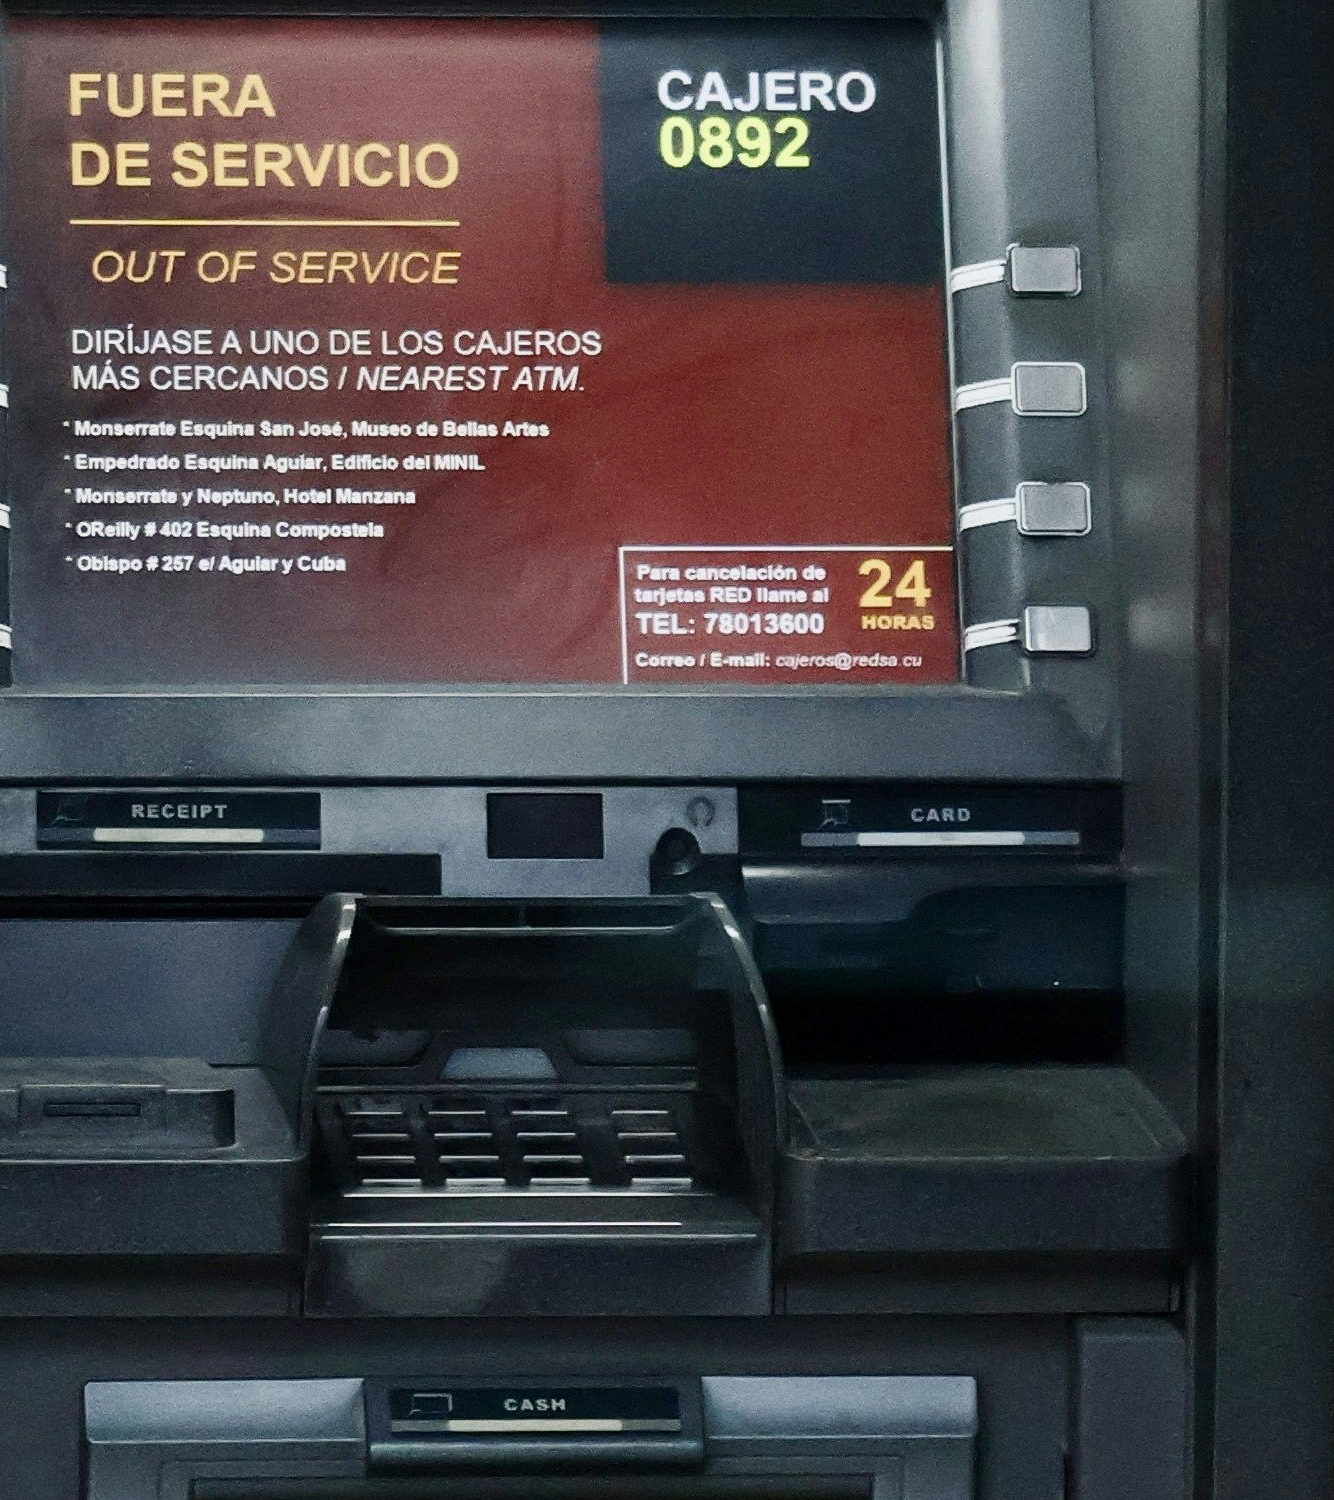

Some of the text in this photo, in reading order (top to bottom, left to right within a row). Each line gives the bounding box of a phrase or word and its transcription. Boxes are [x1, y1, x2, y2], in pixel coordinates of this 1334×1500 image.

[69, 72, 277, 118] FUERA
[657, 69, 876, 113] CAJERO
[659, 115, 810, 168] 0892
[71, 141, 459, 189] DE SERVICIO
[92, 250, 462, 284] OUT OF SERVICE
[71, 323, 602, 356] DIRÍJASE A UNO DE LOS CAJEROS
[72, 358, 140, 390] MÁS
[149, 364, 329, 391] CERCANOS
[356, 365, 509, 391] NEAREST
[511, 365, 585, 392] ATM.
[74, 419, 550, 440] Monserrate Esquina San José, Museo de Bellas Artes
[74, 453, 486, 474] Empedrado Esquina Aguiar, Edificio del MINIL
[74, 487, 416, 507] Monserrate y Neptuno, Hotel Manzana
[143, 521, 157, 537] #
[158, 521, 193, 538] 402
[195, 521, 272, 541] Esquina
[275, 521, 384, 541] Compostela
[77, 555, 143, 575] Obispo
[145, 555, 159, 572] #
[161, 555, 195, 572] 257
[218, 555, 280, 575] Aguiar
[281, 558, 294, 575] y
[297, 555, 347, 572] Cuba
[636, 563, 827, 581] Para cancelación de
[858, 558, 932, 608] 24
[633, 586, 829, 607] tarjetas RED llame al
[634, 611, 825, 635] TEL: 78013600
[861, 614, 935, 630] HORAS
[634, 652, 696, 668] Correo
[709, 651, 771, 668] E-mail:
[131, 803, 228, 819] RECEIPT
[910, 807, 971, 823] CARD
[504, 1398, 566, 1411] CASH
